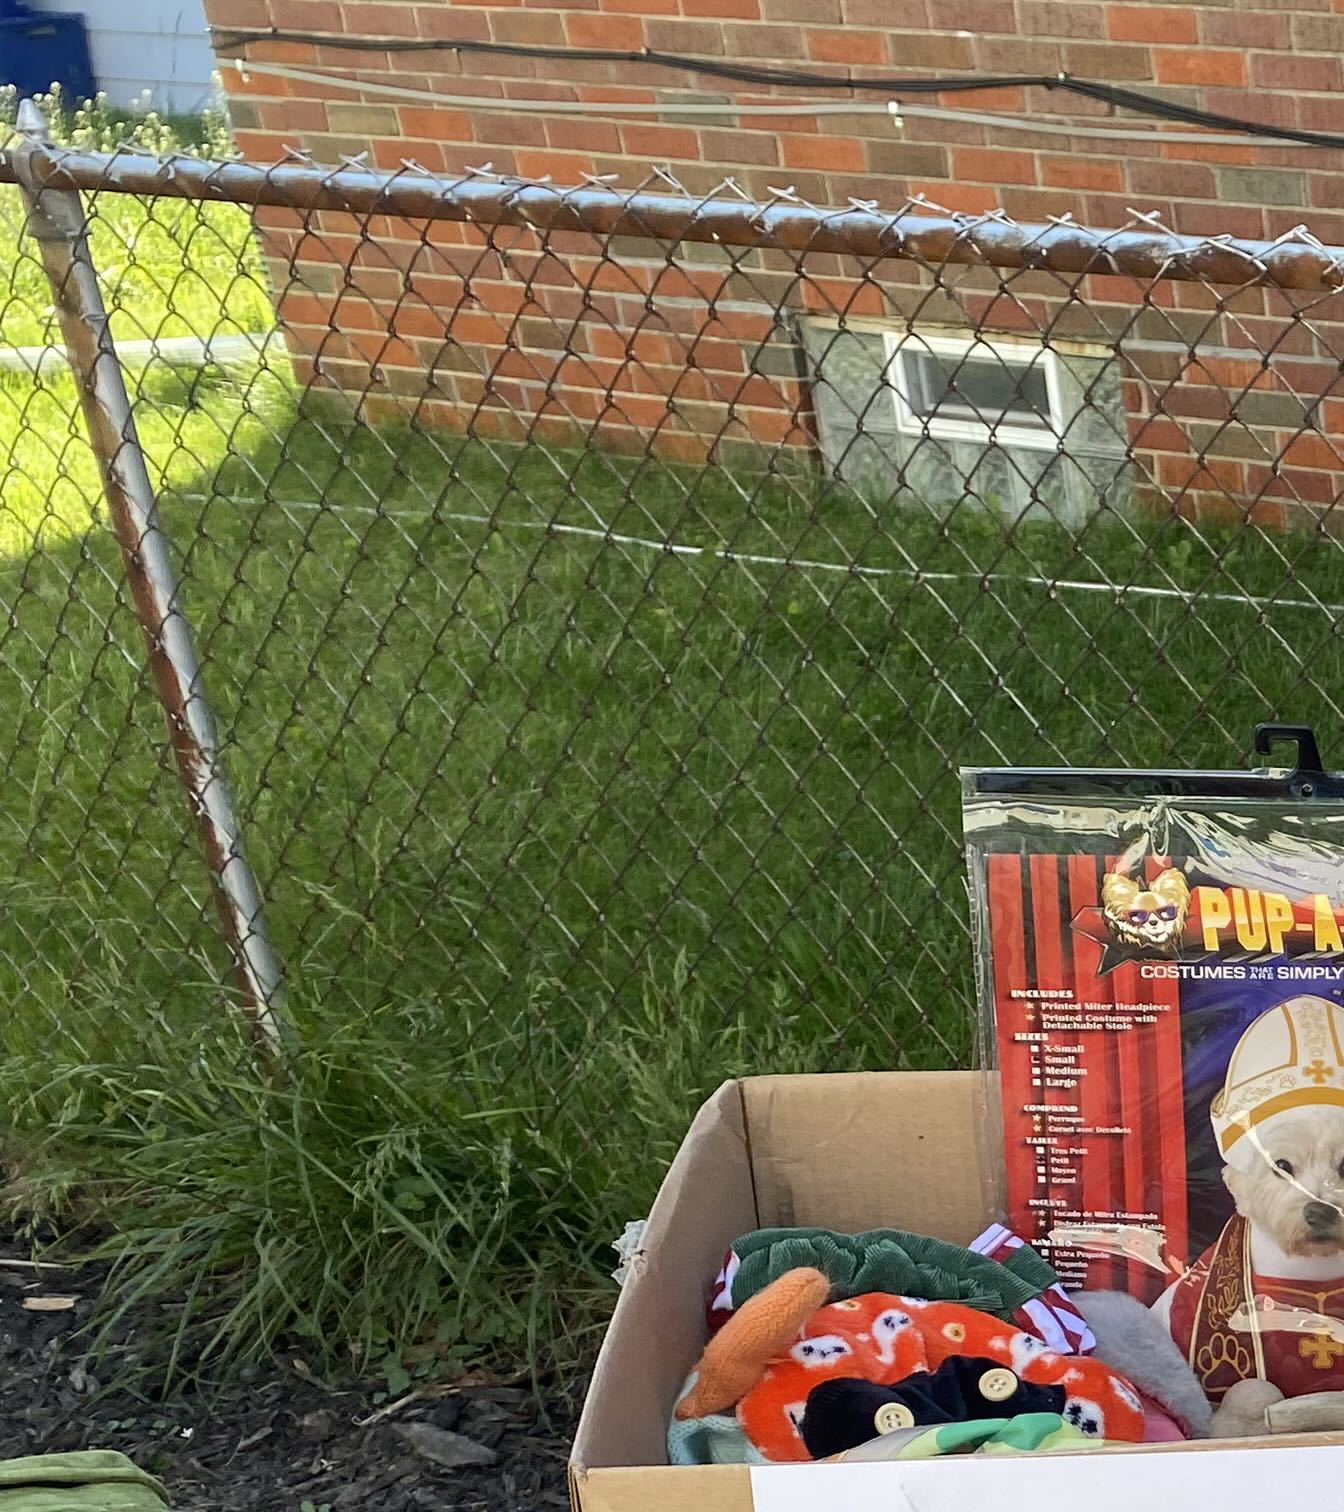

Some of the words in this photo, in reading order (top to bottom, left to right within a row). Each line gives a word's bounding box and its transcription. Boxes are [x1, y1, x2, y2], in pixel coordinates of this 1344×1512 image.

[1140, 966, 1246, 979] COSTUMES
[1277, 966, 1344, 980] SIMPLY
[1011, 990, 1074, 998] INCLUDES
[1041, 1002, 1082, 1011] Printed
[1084, 1002, 1114, 1011] Miter
[1115, 1003, 1171, 1012] Headpiece
[1042, 1014, 1082, 1022] Printed
[1085, 1014, 1132, 1022] Costume
[1134, 1015, 1157, 1023] with
[1043, 1022, 1103, 1030] Detachable
[1105, 1022, 1133, 1030] Stole
[1014, 1033, 1049, 1041] SIZES
[1044, 1045, 1085, 1053] X-Small
[1044, 1056, 1076, 1064] Small
[1045, 1067, 1088, 1076] Medium
[1045, 1079, 1077, 1088] Large
